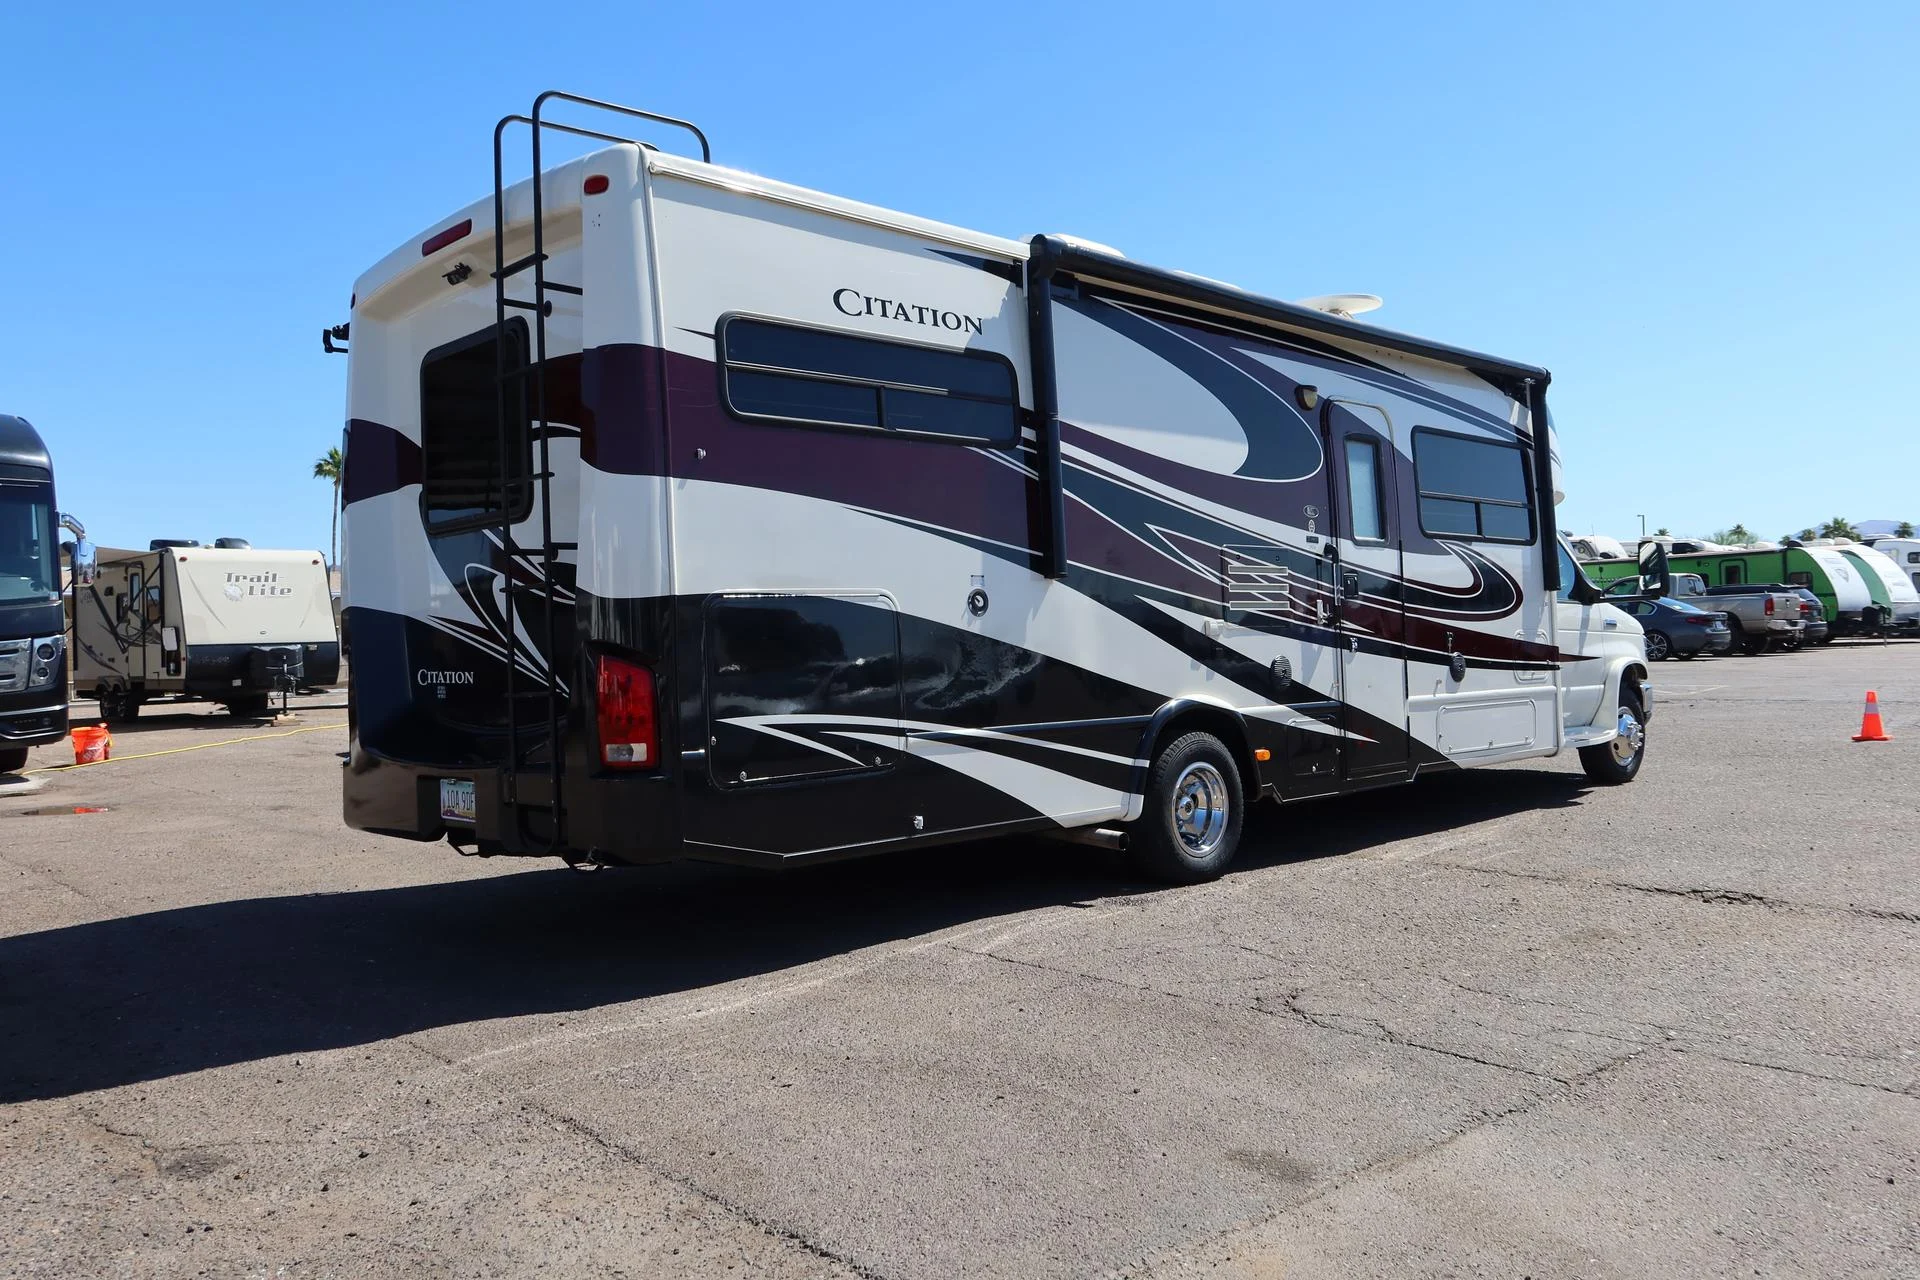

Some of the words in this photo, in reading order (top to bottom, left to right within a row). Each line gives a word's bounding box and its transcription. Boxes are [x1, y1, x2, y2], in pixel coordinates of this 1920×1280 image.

[833, 288, 983, 335] CITATION
[224, 571, 278, 583] Trail
[248, 583, 293, 596] Lite
[417, 668, 474, 686] CITATION
